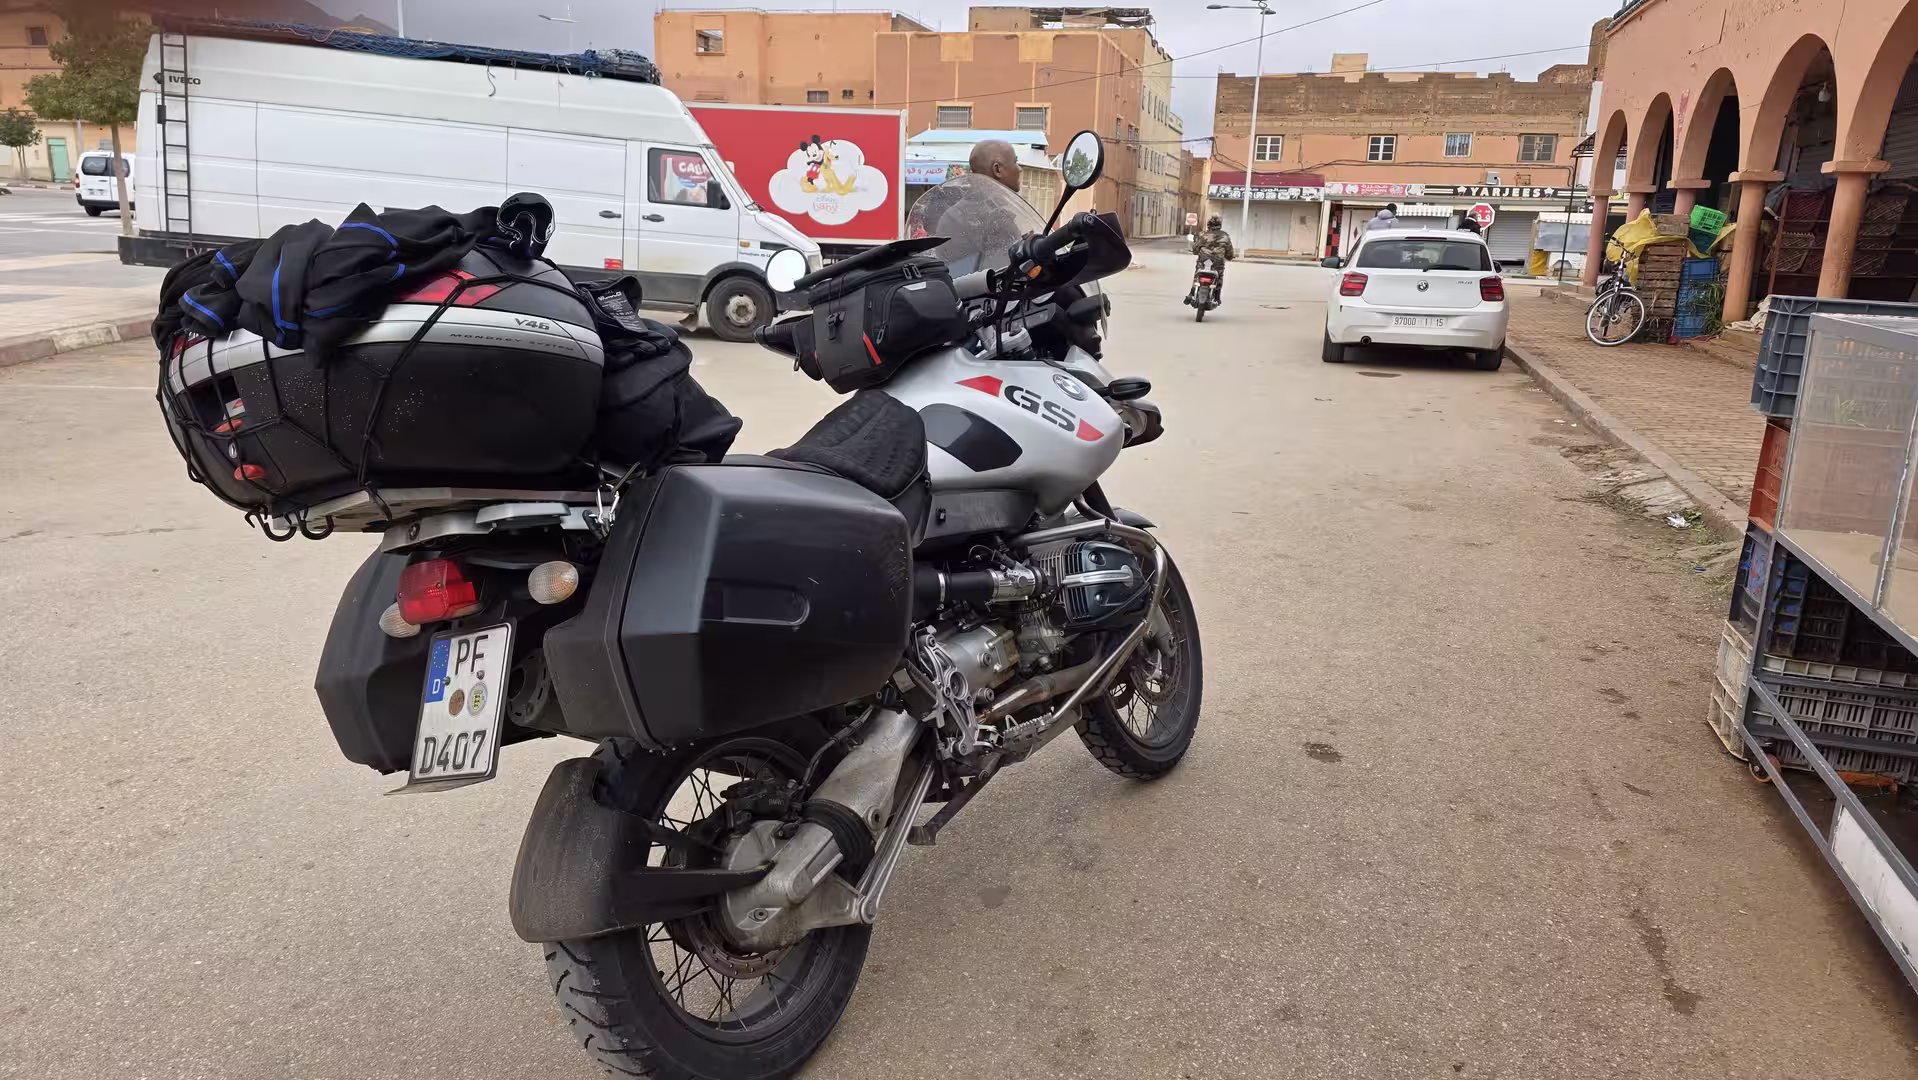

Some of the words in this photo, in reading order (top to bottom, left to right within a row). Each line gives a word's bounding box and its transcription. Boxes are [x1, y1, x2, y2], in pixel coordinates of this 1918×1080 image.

[168, 75, 202, 86] IVECO
[1470, 187, 1541, 198] YARJEES
[514, 317, 550, 331] V46
[1394, 316, 1417, 326] 97000
[1436, 318, 1444, 327] 15
[529, 340, 575, 351] SYSTEM
[1004, 385, 1076, 432] GS
[454, 634, 489, 676] PF
[432, 678, 441, 695] D
[418, 729, 487, 775] D407
